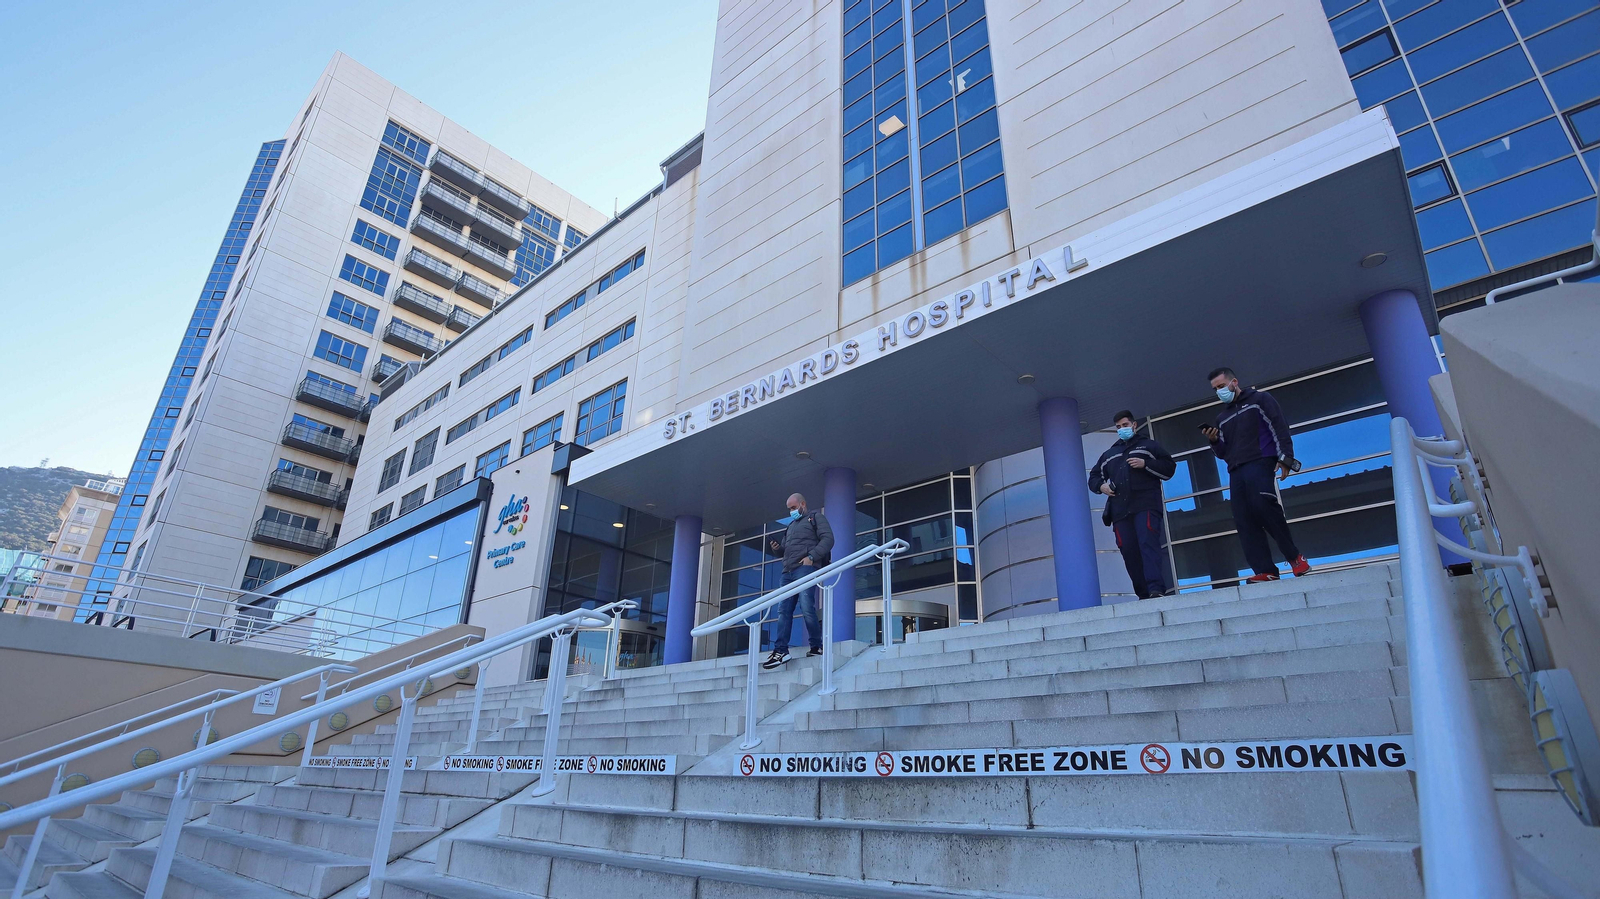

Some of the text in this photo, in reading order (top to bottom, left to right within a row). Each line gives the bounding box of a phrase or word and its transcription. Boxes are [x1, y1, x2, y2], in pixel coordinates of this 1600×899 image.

[663, 245, 1089, 439] ST. BERNARDS HOSPITAL
[494, 494, 524, 534] gha
[487, 540, 526, 560] Primary Care
[494, 556, 514, 569] Centre
[336, 758, 351, 767] SMOKE
[351, 758, 363, 767] FREE
[363, 758, 376, 767] ZONE
[380, 759, 388, 767] NO
[451, 758, 462, 768] NO
[462, 758, 494, 769] SMOKING
[506, 758, 534, 770] SMOKE
[558, 758, 584, 771] ZONE
[600, 758, 614, 771] NO
[616, 758, 666, 772] SMOKING
[759, 742, 1407, 773] NO SMOKING SMOKE FREE ZONE NO SMOKING
